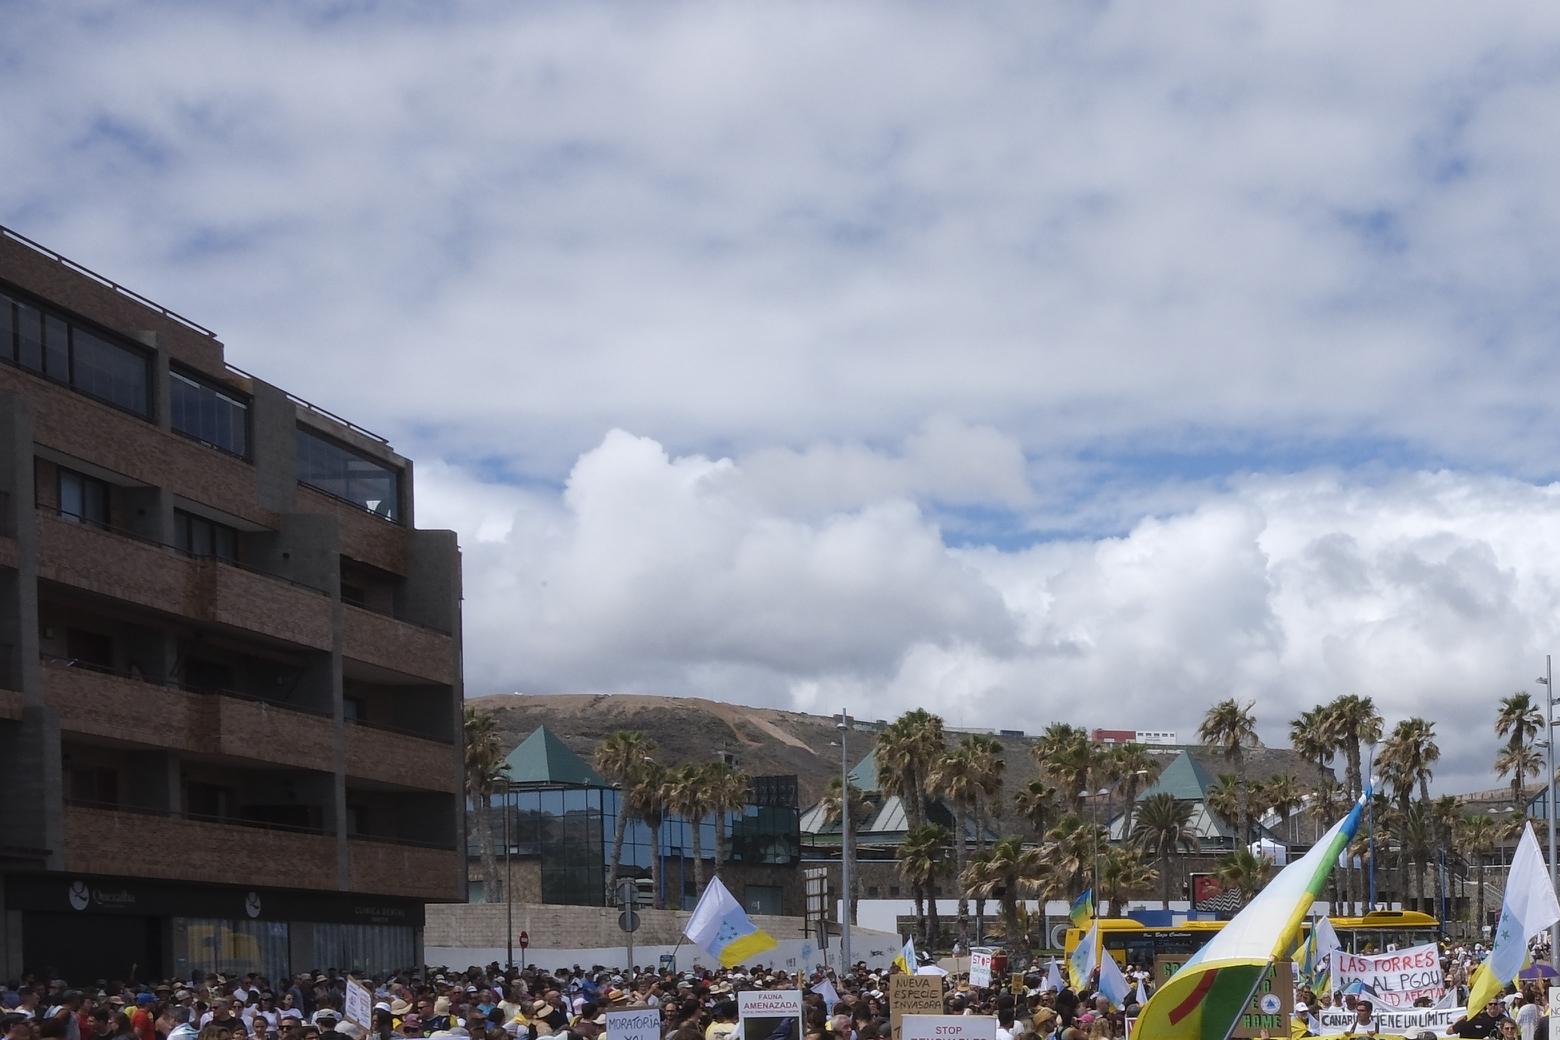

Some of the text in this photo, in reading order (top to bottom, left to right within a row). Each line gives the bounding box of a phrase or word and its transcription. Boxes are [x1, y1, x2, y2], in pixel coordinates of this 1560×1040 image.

[973, 954, 990, 966] STOP
[1340, 951, 1435, 973] LAS TORRES
[896, 978, 930, 988] NUEVA
[1372, 976, 1393, 991] AL
[1400, 970, 1440, 989] PGOU
[894, 989, 939, 999] ESPECIE
[743, 1001, 798, 1010] AMENAZADA
[893, 1000, 942, 1009] INVASORA
[1321, 1013, 1356, 1027] CANARI
[1404, 1014, 1417, 1028] UN
[935, 1026, 962, 1035] STOP
